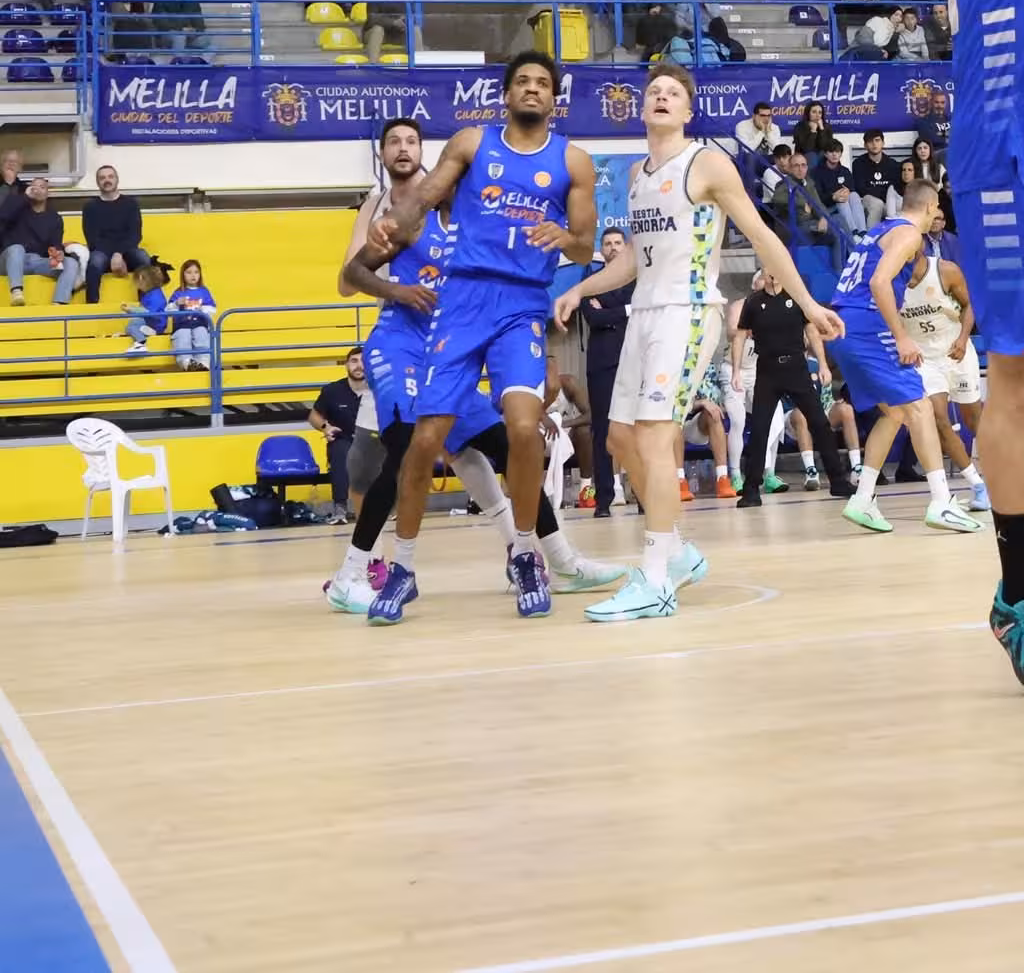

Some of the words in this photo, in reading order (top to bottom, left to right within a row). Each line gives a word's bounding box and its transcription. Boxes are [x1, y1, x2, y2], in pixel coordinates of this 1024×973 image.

[109, 76, 237, 110] MELILLA
[315, 86, 358, 97] CIUDAD
[361, 84, 430, 97] AUTÓNOMA
[694, 83, 748, 95] UTÓNOMA
[769, 73, 880, 104] MELILLA
[320, 98, 432, 122] MELILLA
[698, 96, 750, 117] ILLA
[837, 104, 877, 115] DEPORTE
[112, 110, 153, 124] CIUDAD
[158, 112, 179, 124] DEL
[185, 110, 234, 124] DEPORTE
[507, 226, 517, 250] 1
[919, 320, 936, 333] 55
